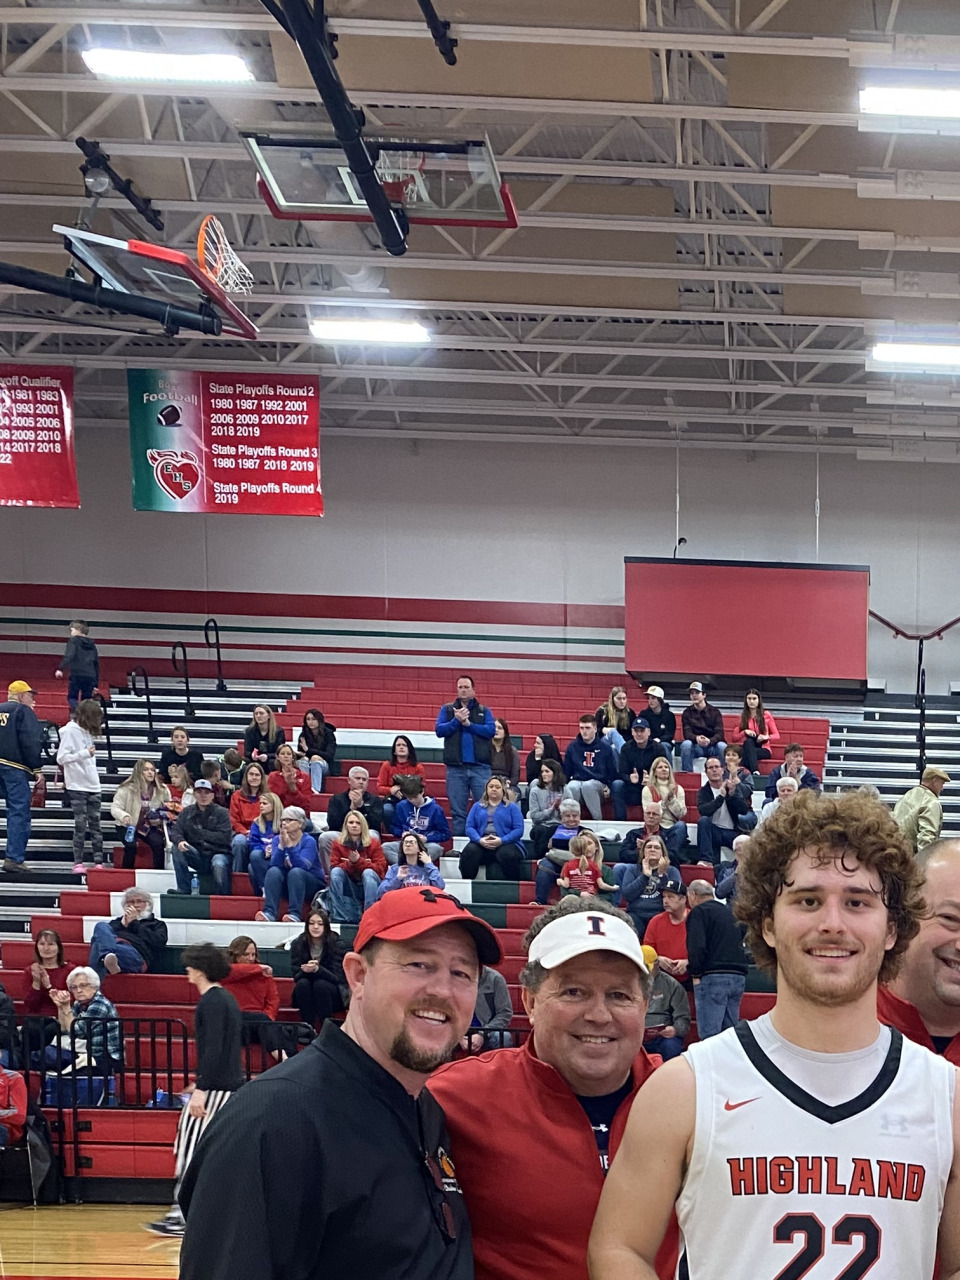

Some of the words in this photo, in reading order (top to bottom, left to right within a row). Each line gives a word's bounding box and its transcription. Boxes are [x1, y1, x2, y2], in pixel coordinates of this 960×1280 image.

[21, 376, 61, 387] Qualifier
[11, 390, 33, 400] 1981
[36, 391, 59, 401] 1983
[209, 383, 234, 394] State
[236, 384, 274, 397] Playoffs
[276, 385, 307, 396] Round
[12, 403, 34, 414] 1993
[36, 404, 59, 415] 2001
[210, 399, 233, 409] 1980
[236, 400, 258, 410] 1987
[261, 400, 283, 410] 1992
[285, 401, 307, 411] 2001
[11, 417, 35, 427] 2005
[37, 418, 60, 428] 2006
[210, 414, 234, 424] 2006
[236, 414, 259, 424] 2009
[262, 414, 285, 425] 2010
[285, 415, 309, 425] 2017
[12, 430, 35, 440] 2009
[37, 431, 61, 441] 2010
[211, 426, 235, 436] 2018
[237, 426, 260, 437] 2019
[12, 442, 35, 452] 2017
[37, 443, 62, 453] 2018
[212, 444, 236, 455] State
[238, 445, 276, 458] Playoffs
[278, 446, 309, 457] Round
[311, 447, 318, 457] 3
[213, 458, 235, 469] 1980
[238, 459, 260, 469] 1987
[264, 460, 287, 470] 2018
[290, 461, 314, 472] 2019
[214, 483, 238, 493] State
[241, 483, 279, 496] Playoffs
[282, 484, 315, 494] Round
[215, 494, 239, 504] 2019
[82, 876, 86, 884] K
[54, 899, 58, 908] J
[24, 923, 30, 932] H
[587, 916, 605, 936] I
[726, 1156, 926, 1202] HIGHLAND
